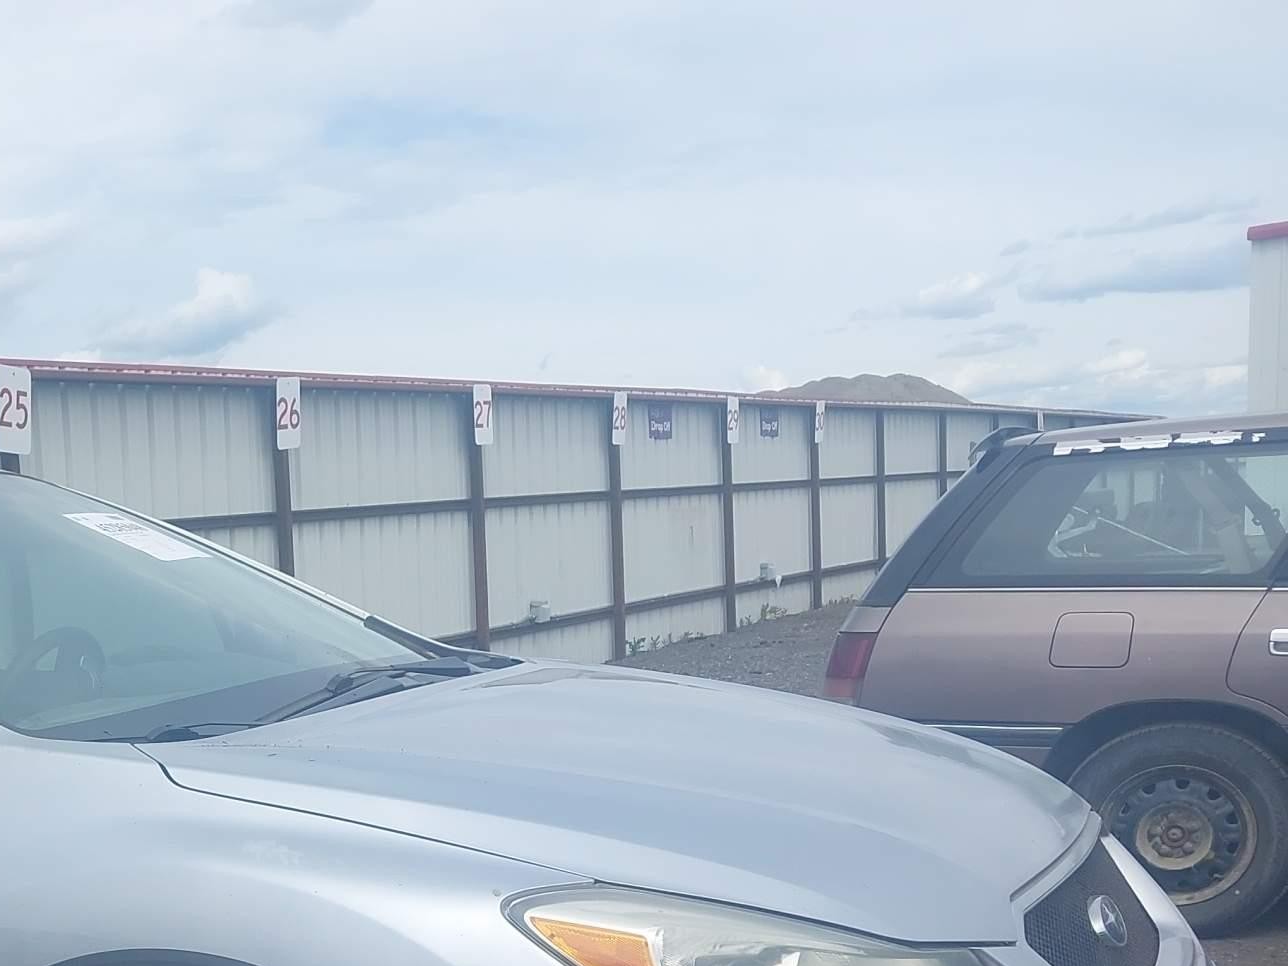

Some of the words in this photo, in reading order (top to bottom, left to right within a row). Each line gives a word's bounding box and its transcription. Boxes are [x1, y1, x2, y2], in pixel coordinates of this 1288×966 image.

[0, 387, 29, 430] 25
[277, 397, 300, 430] 26
[474, 400, 492, 429] 27
[614, 406, 626, 431] 28
[728, 409, 739, 431] 29
[816, 411, 824, 431] 30
